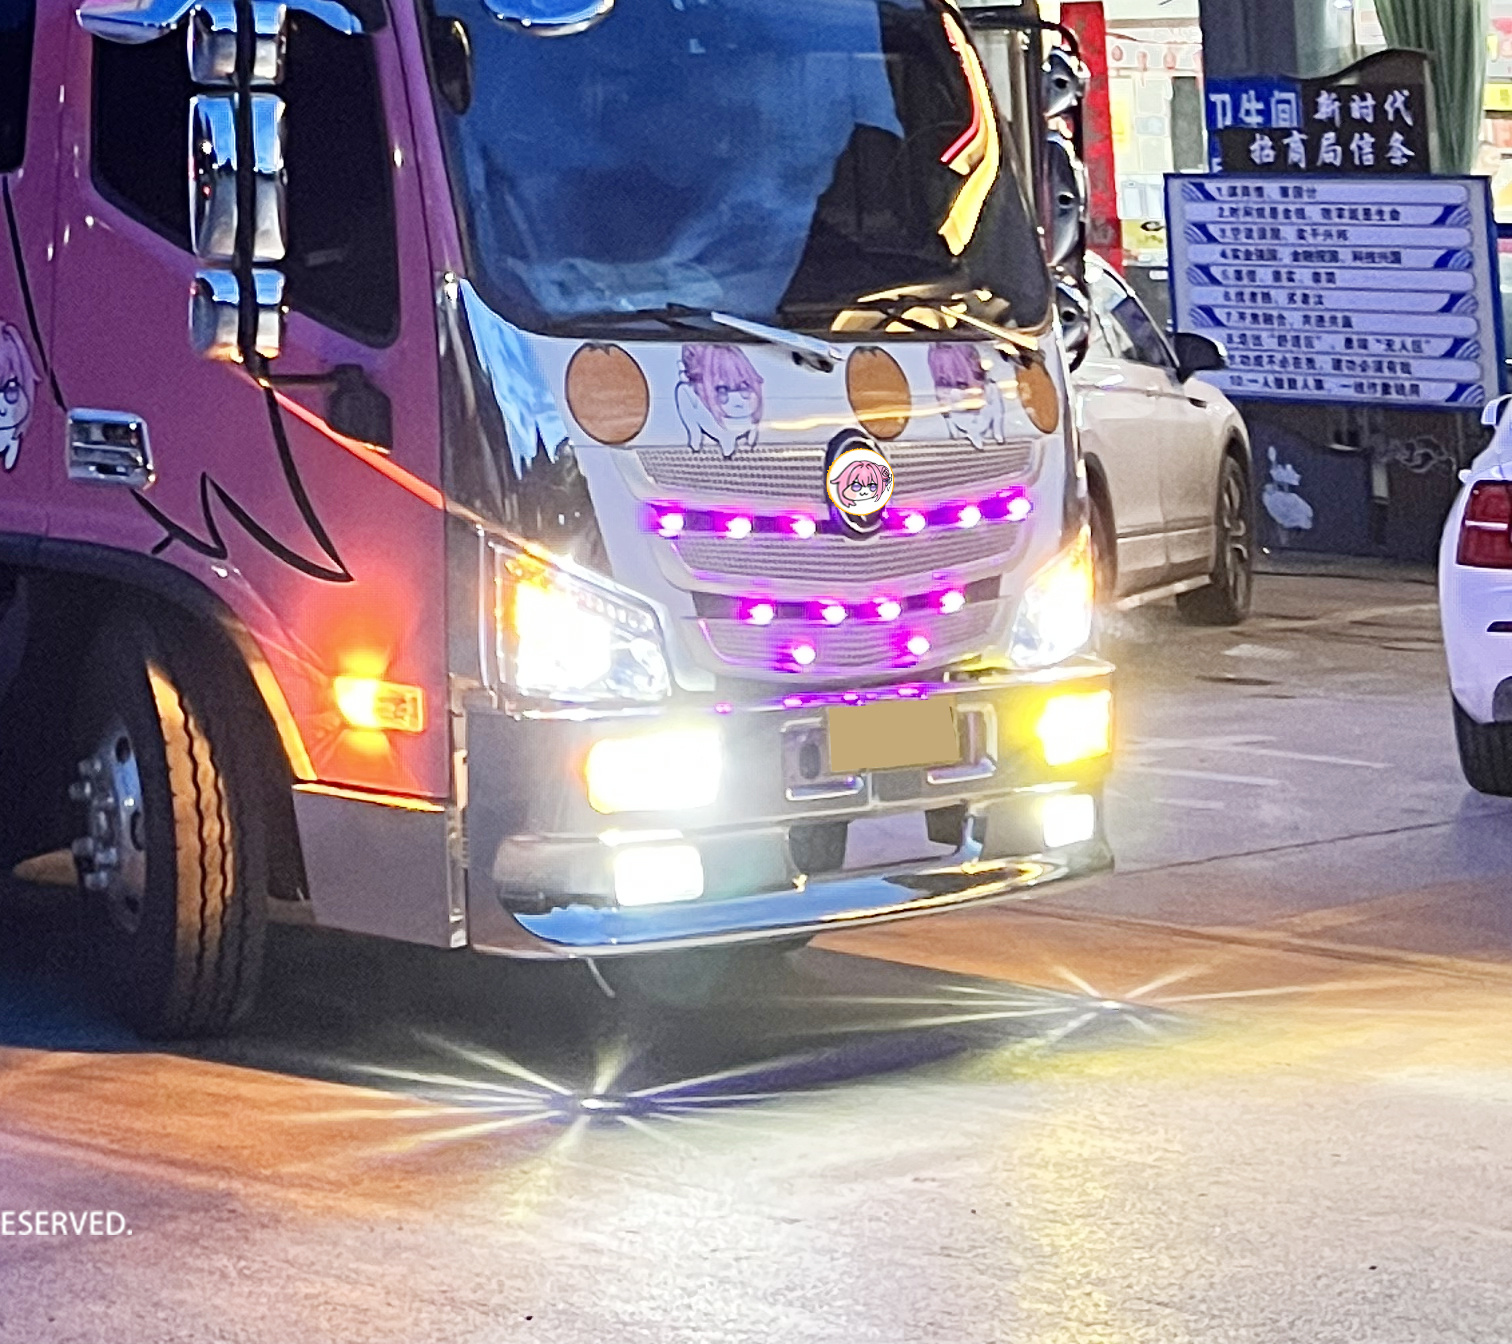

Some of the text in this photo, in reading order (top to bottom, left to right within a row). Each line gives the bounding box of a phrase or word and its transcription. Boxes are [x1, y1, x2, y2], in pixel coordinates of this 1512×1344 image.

[1209, 90, 1299, 130] 卫生间
[1312, 89, 1414, 128] 新时代
[1249, 130, 1416, 170] 招商局信条
